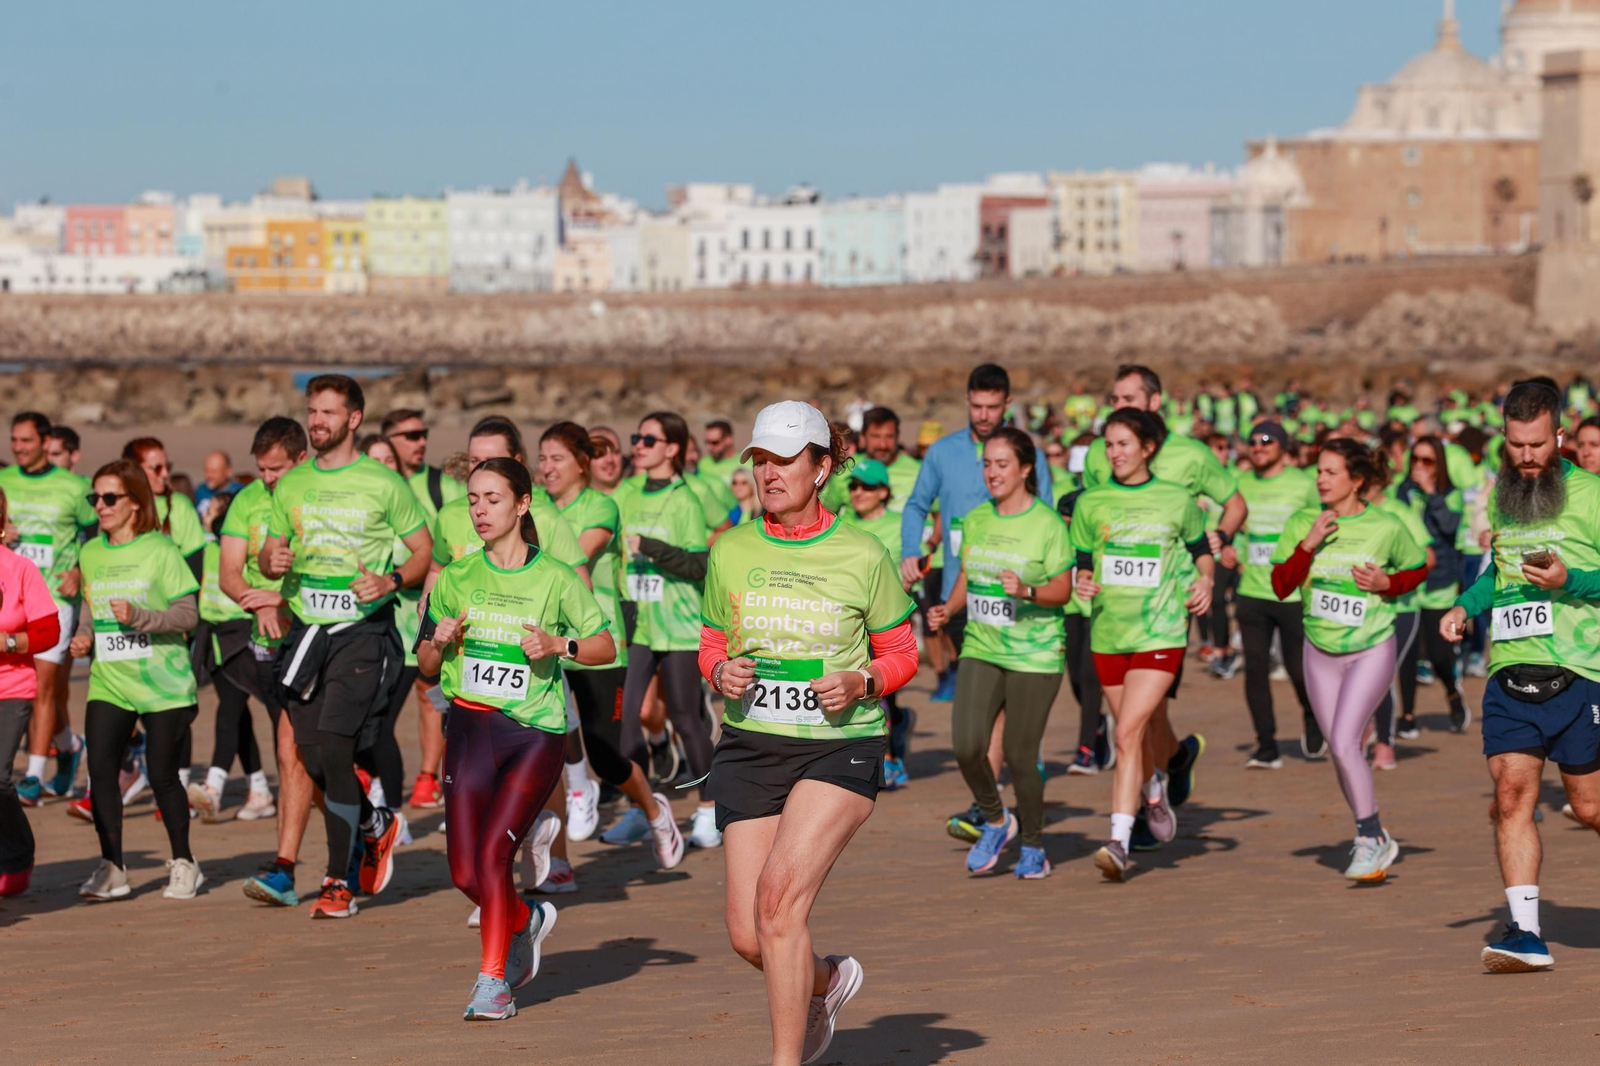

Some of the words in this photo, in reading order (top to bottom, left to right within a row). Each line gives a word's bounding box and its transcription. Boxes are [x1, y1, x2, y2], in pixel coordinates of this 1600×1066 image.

[1113, 560, 1157, 577] 5017
[310, 592, 351, 610] 1778
[745, 591, 767, 607] En
[772, 596, 843, 614] marcha
[973, 598, 1012, 616] 1066
[1320, 595, 1363, 617] 5016
[468, 606, 486, 620] En
[1503, 605, 1547, 629] 1676
[467, 626, 522, 645] contra
[743, 613, 815, 634] contra
[819, 618, 840, 637] el
[106, 633, 148, 651] 3878
[472, 663, 525, 689] 1475
[754, 684, 819, 711] 2138
[1591, 704, 1600, 726] RUN
